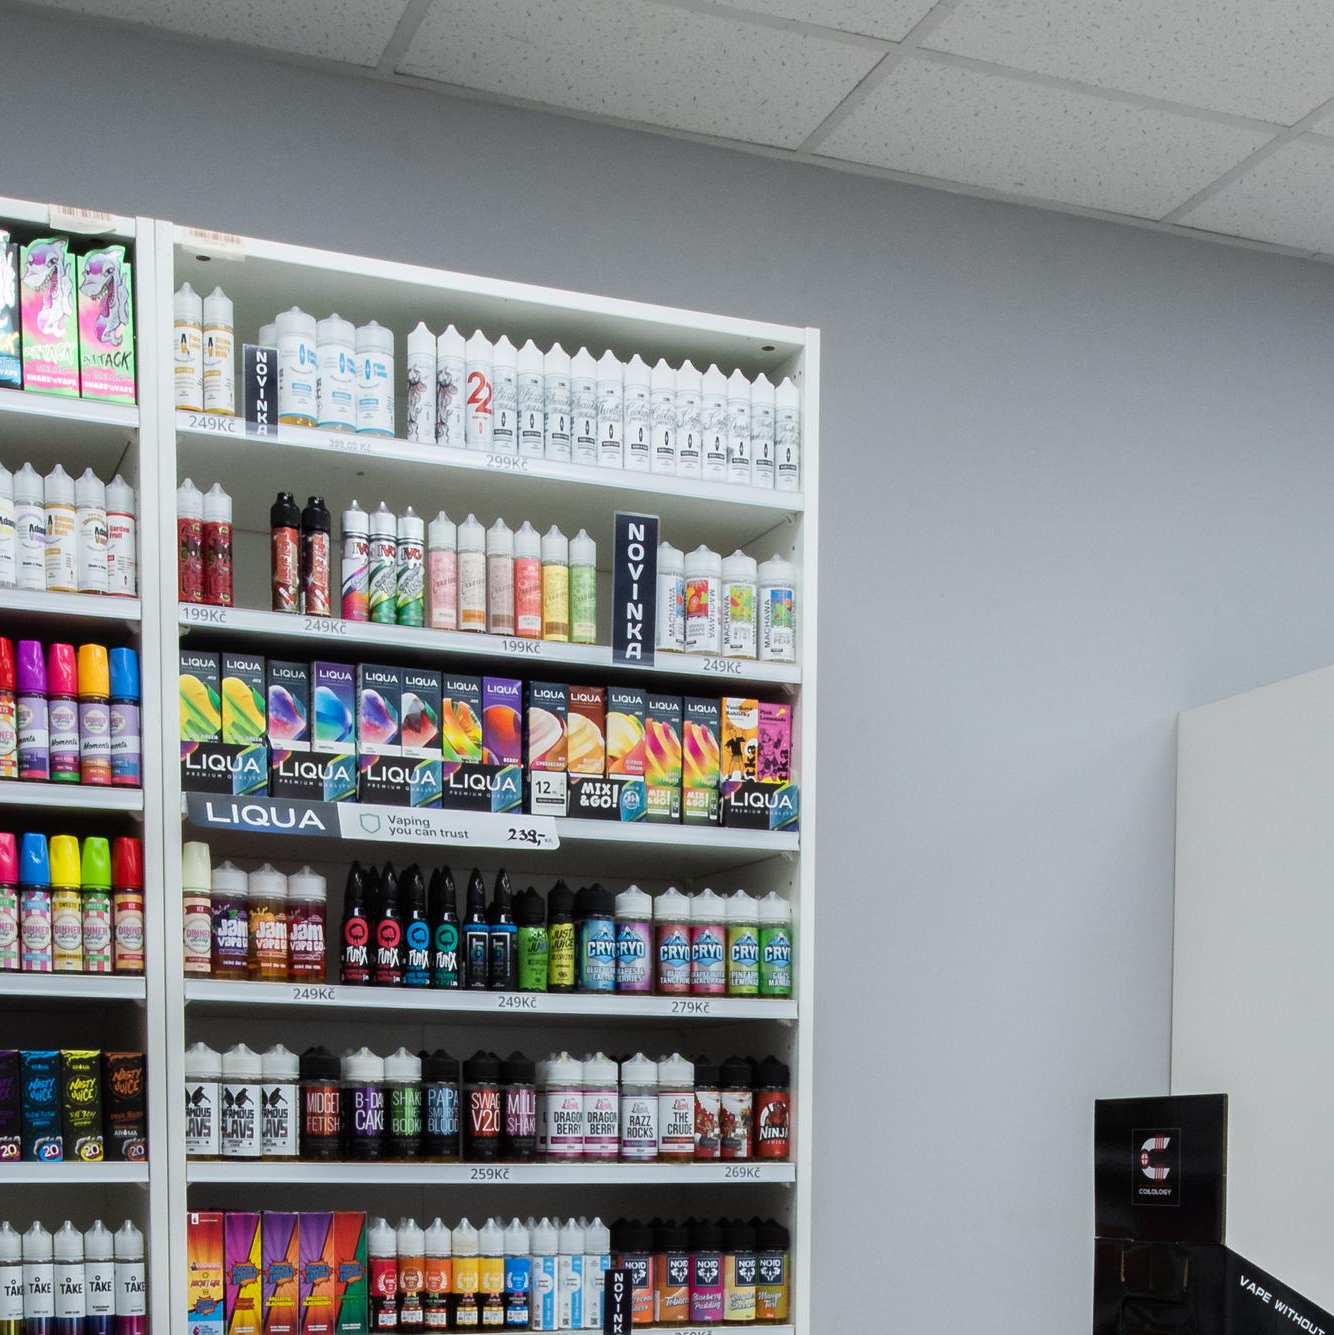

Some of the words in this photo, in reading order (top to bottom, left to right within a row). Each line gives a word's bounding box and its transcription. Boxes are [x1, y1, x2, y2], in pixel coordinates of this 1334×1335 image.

[83, 350, 133, 370] ATTACK
[255, 351, 270, 436] NOVINKA
[188, 414, 236, 433] 249Kč
[485, 454, 529, 472] 299Kč
[626, 522, 646, 661] NOVINKA
[182, 608, 227, 624] 199Kč
[304, 618, 348, 634] 249Kč
[501, 640, 541, 655] 199Kč
[181, 657, 216, 669] LIQUA
[226, 660, 261, 671] LIQUA
[703, 659, 742, 675] 249Kč
[273, 668, 306, 679] LIQUA
[319, 669, 352, 681] LIQUA
[365, 672, 398, 683] LIQUA
[405, 676, 438, 688] LIQUA
[447, 681, 479, 692] LIQUA
[487, 684, 518, 695] LIQUA
[534, 689, 565, 700] LIQUA
[570, 693, 601, 703] LIQUA
[612, 694, 642, 705] LIQUA
[649, 701, 679, 712] LIQUA
[688, 703, 717, 715] LIQUA
[186, 753, 261, 773] LIQUA
[279, 760, 349, 780] LIQUA
[367, 765, 436, 786] LIQUA
[450, 772, 517, 792] LIQUA
[535, 780, 551, 794] 12
[580, 781, 611, 795] MIX
[730, 792, 793, 810] LIQUA
[205, 801, 326, 831] LIQUA
[387, 815, 430, 828] Vaping
[389, 827, 411, 837] you
[415, 828, 436, 838] can
[440, 829, 469, 840] trust
[692, 943, 723, 959] CRYO
[293, 987, 335, 1000] 249Kč
[498, 996, 537, 1009] 249Kč
[671, 1001, 710, 1014] 279Kč
[306, 1092, 340, 1114] MIDGET
[587, 1111, 617, 1123] DRAGON
[629, 1115, 651, 1126] RAZZ
[673, 1112, 689, 1123] THE
[306, 1117, 340, 1132] FETISH
[589, 1123, 615, 1135] BERRY
[667, 1123, 692, 1135] CRUDE
[627, 1126, 653, 1138] ROCKS
[470, 1167, 509, 1181] 259Kč
[724, 1165, 760, 1179] 269Kč
[697, 1259, 719, 1268] NOID
[759, 1257, 781, 1267] NOID
[1239, 1275, 1272, 1303] VAPE
